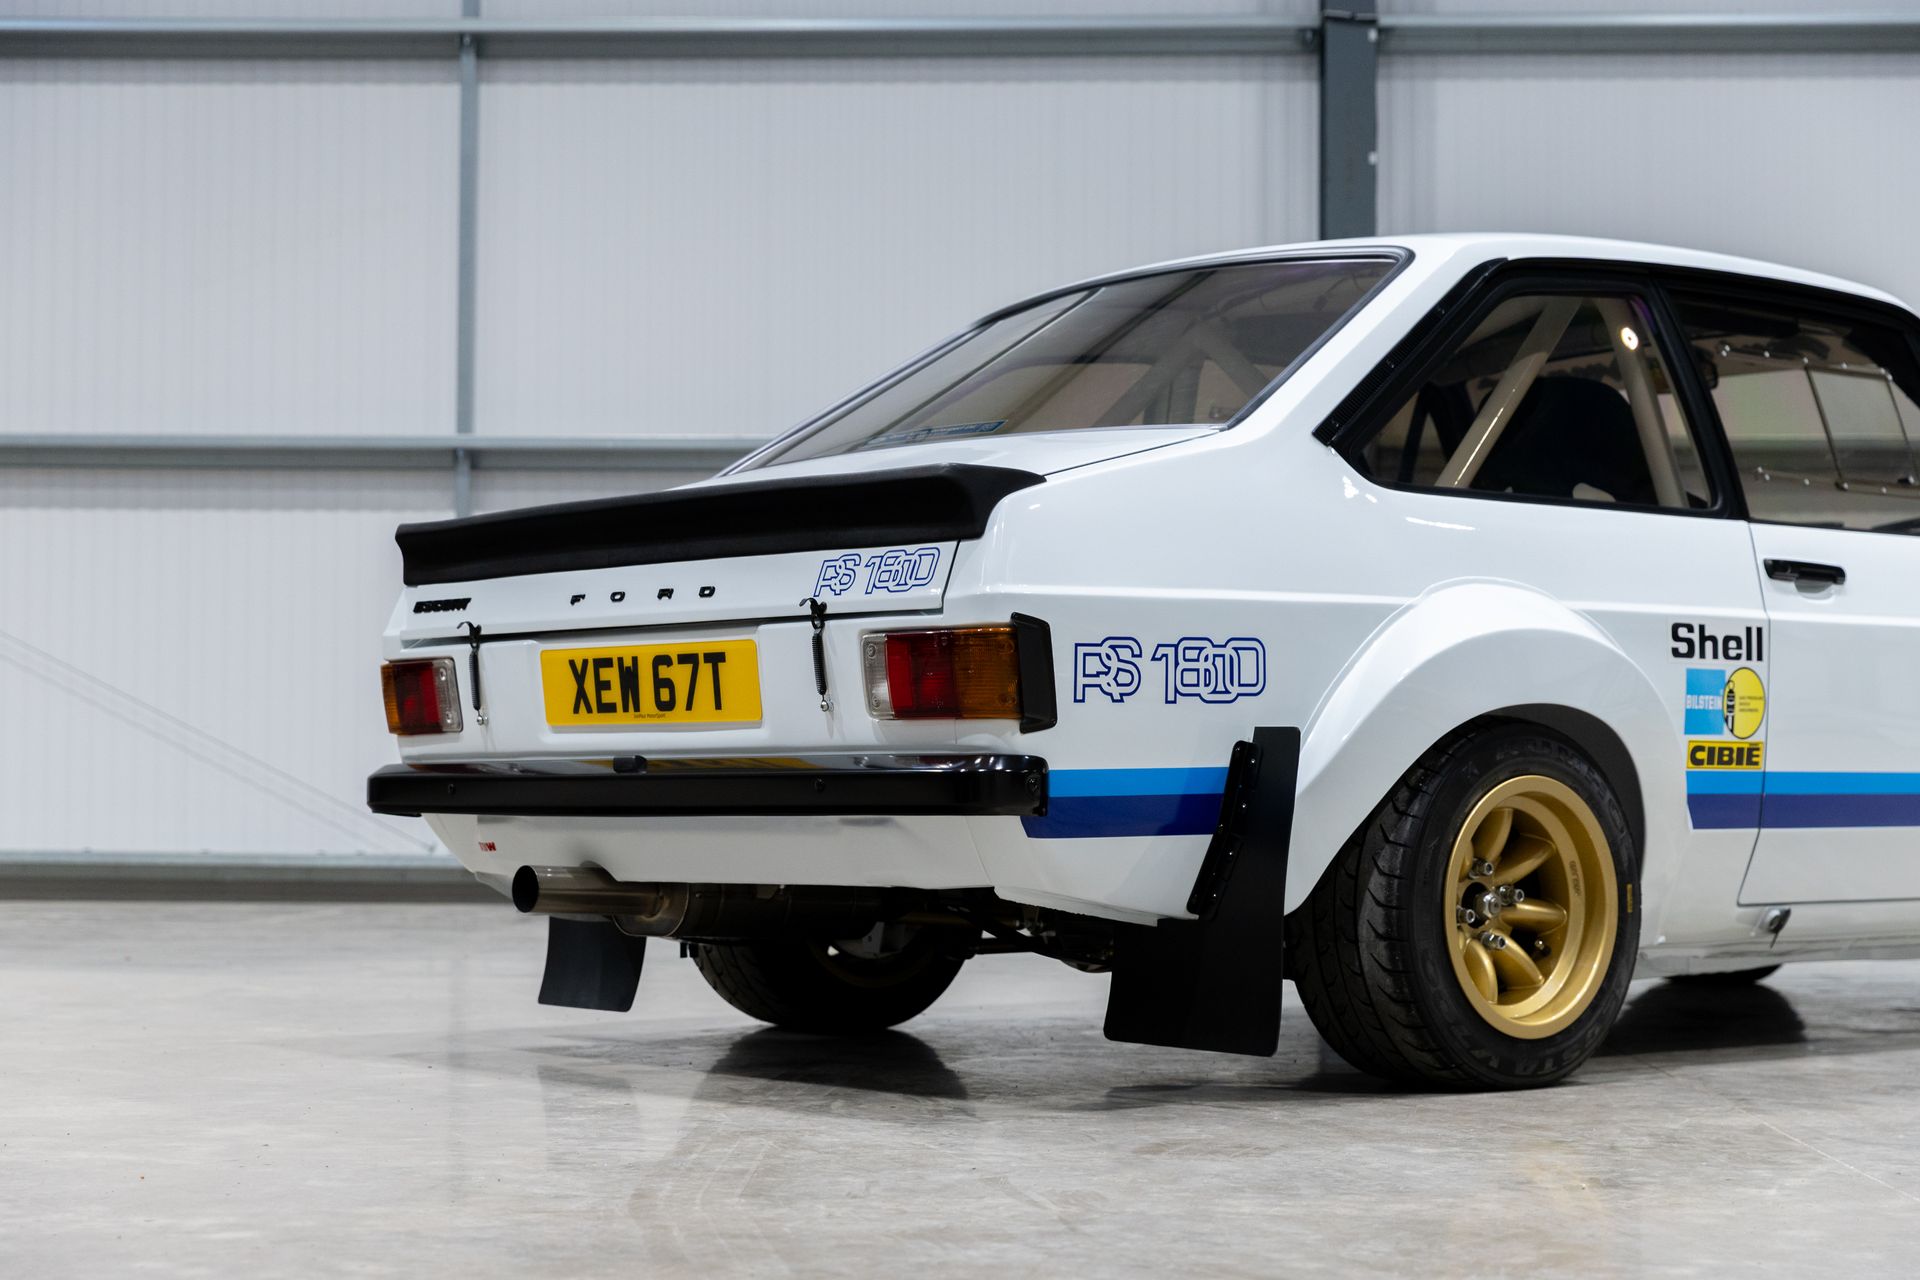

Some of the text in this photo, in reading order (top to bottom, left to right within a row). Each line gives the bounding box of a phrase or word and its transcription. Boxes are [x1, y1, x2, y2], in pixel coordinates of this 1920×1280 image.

[814, 553, 861, 597] RS
[570, 586, 716, 606] FORD
[1671, 622, 1763, 661] Shell
[568, 652, 726, 714] XEW 67T
[1073, 636, 1143, 703] RS
[1686, 694, 1723, 710] BILSTEIN
